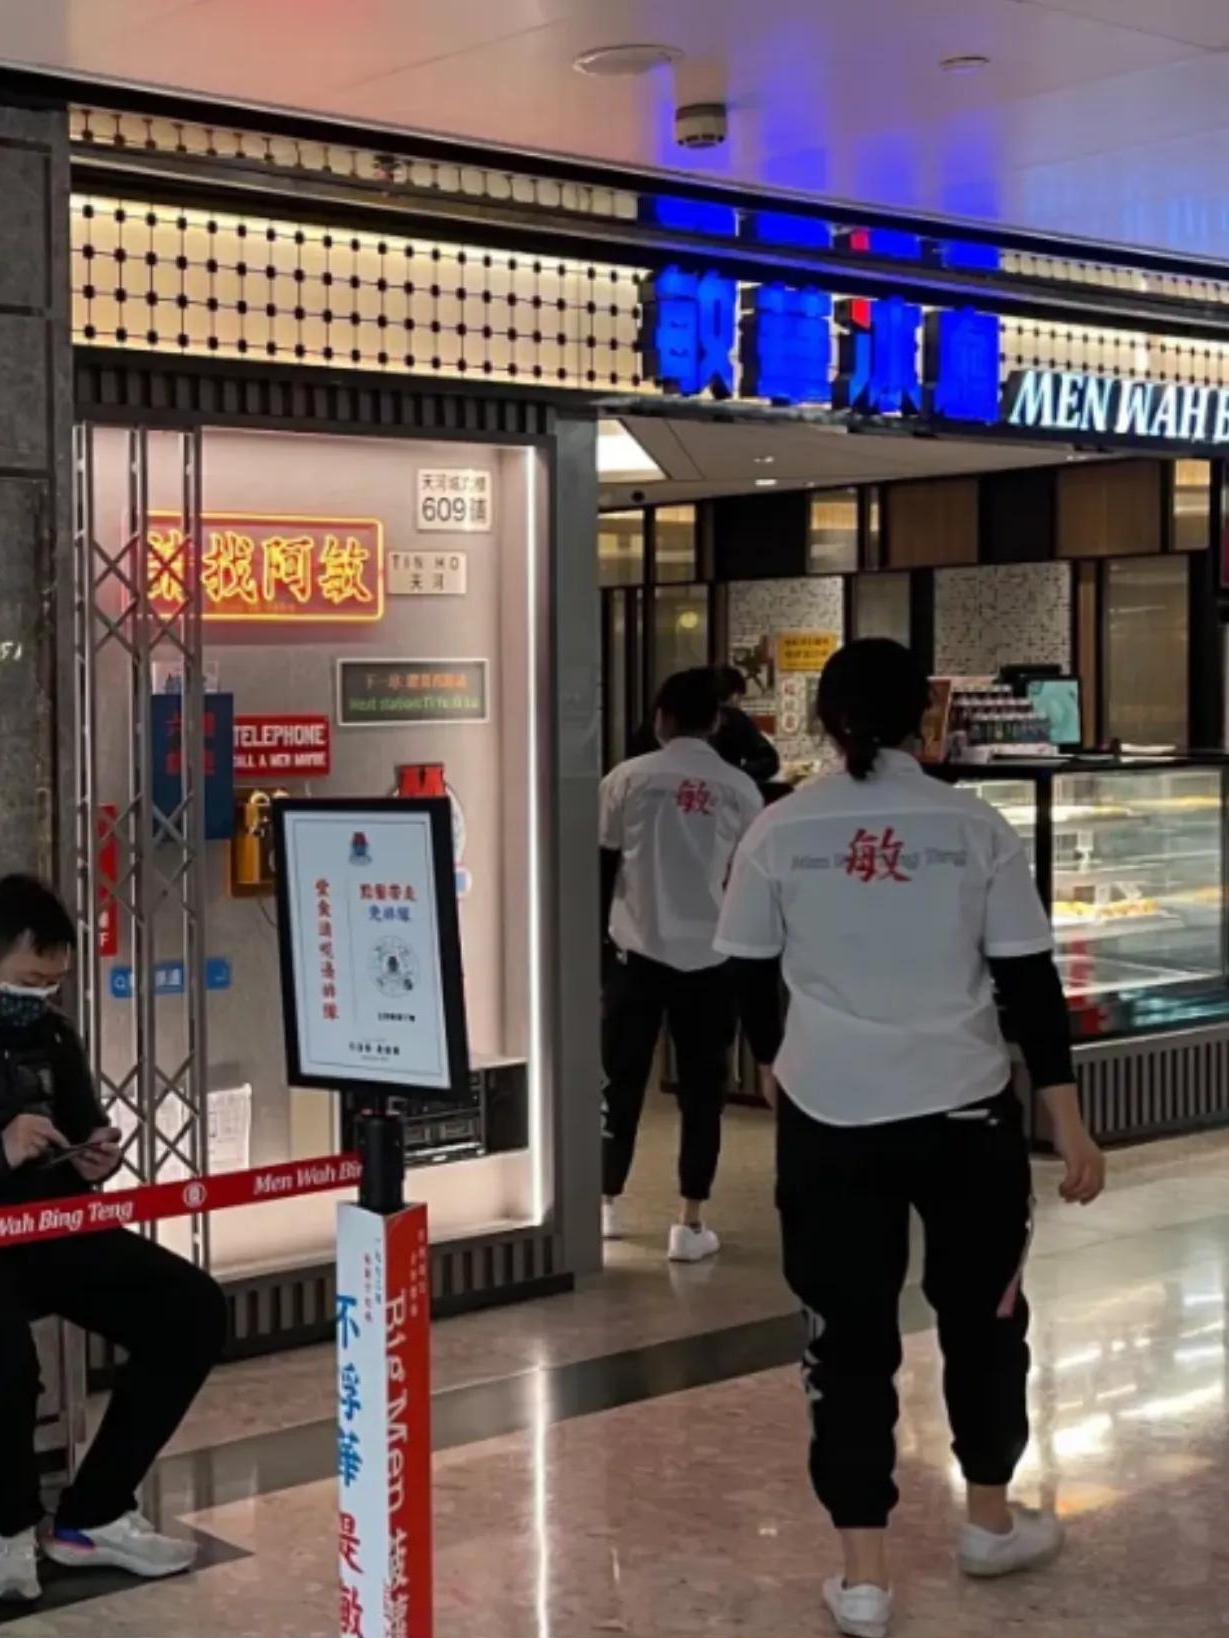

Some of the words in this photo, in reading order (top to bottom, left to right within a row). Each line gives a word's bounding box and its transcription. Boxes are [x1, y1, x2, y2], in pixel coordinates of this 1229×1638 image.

[1007, 370, 1114, 432] MEN
[1114, 380, 1212, 439] WAH
[392, 554, 422, 571] TIN
[233, 724, 326, 748] TELEPHONE
[676, 779, 715, 816] 敏
[846, 826, 912, 882] 敏
[253, 1172, 294, 1195] Men
[296, 1166, 336, 1188] Wah
[38, 1207, 84, 1232] Bing
[88, 1200, 134, 1224] Teng
[386, 1389, 409, 1514] Men
